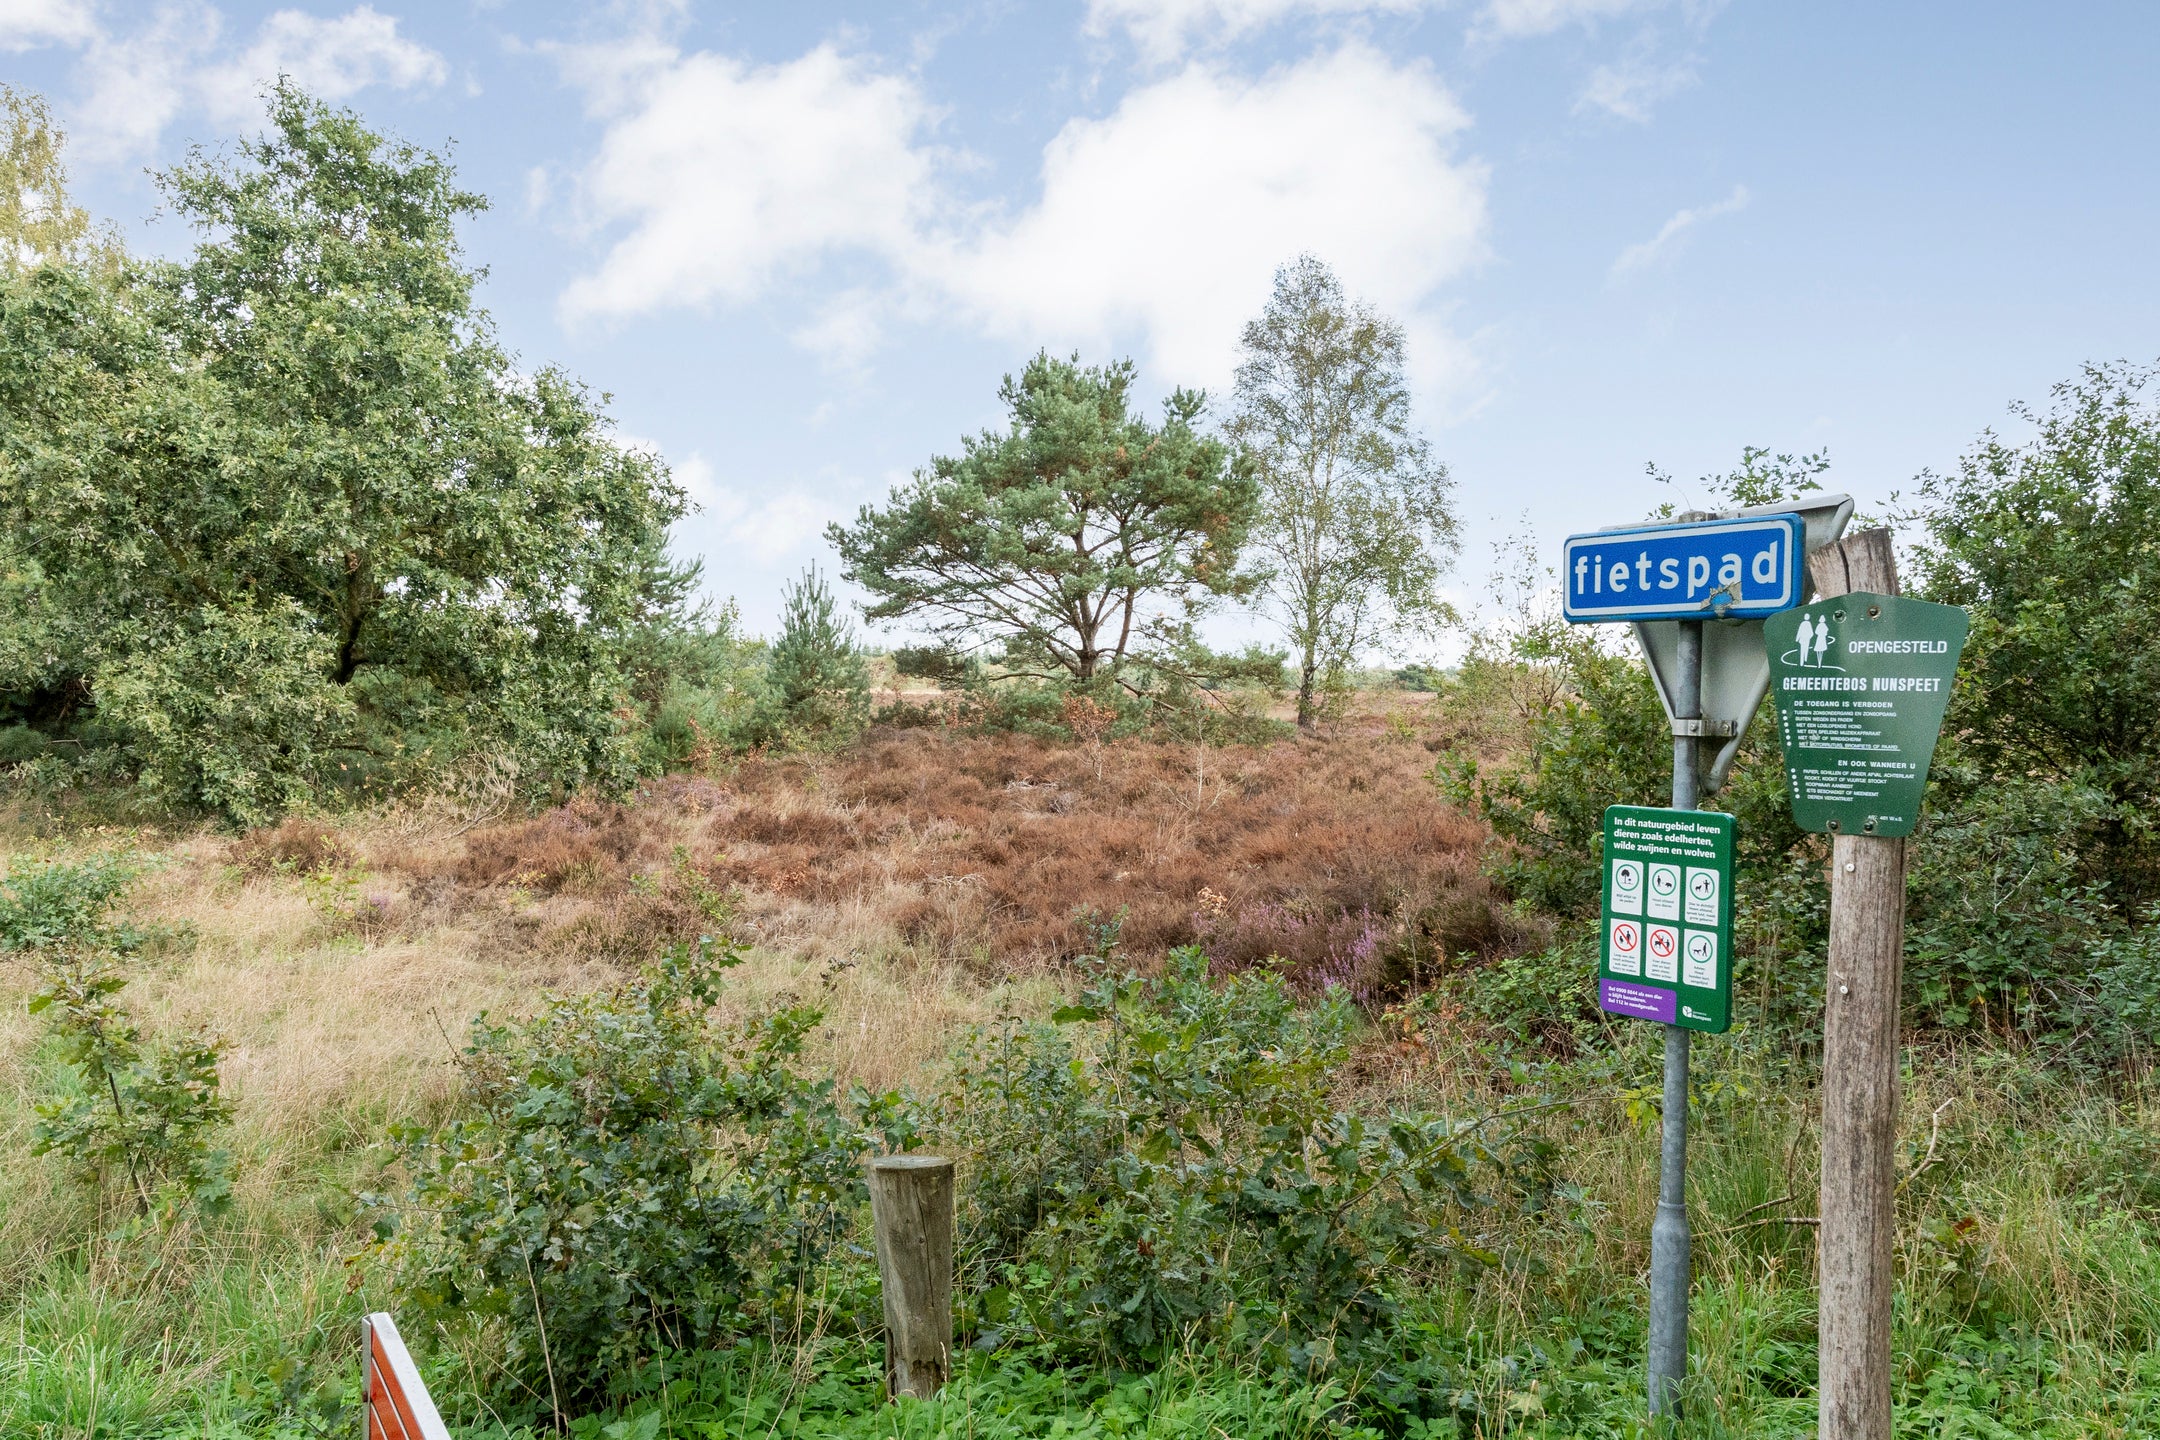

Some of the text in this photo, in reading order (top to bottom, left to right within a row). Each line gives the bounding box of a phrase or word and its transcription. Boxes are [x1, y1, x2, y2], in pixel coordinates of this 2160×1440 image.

[1575, 541, 1777, 599] fietspad
[1849, 641, 1947, 653] OPENGESTELD
[1783, 677, 1940, 692] GEMEENTEBOS NUNSPEET
[1614, 817, 1720, 834] In dit natuurgebied leven
[1614, 829, 1713, 847] dieren zoals edelherten,
[1614, 841, 1635, 850] wilde
[1637, 844, 1669, 854] zwijnen
[1684, 848, 1715, 858] wolven
